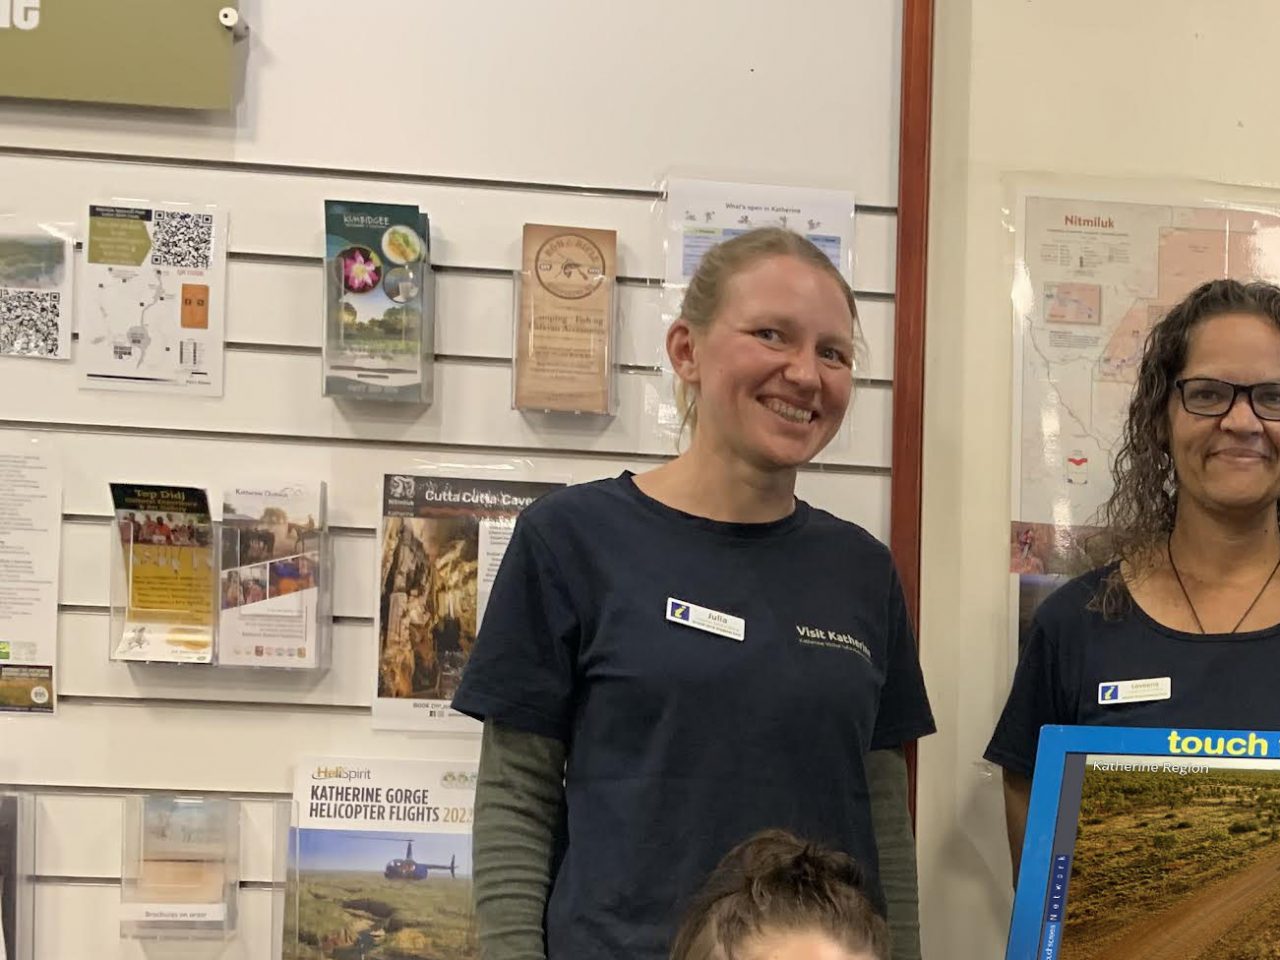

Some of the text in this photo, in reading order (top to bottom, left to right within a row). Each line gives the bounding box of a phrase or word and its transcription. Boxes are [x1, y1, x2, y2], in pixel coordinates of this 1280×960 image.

[1064, 215, 1114, 228] Nitmiluk
[425, 490, 460, 502] Cutta
[463, 491, 498, 505] Cutta
[708, 613, 728, 624] Julia
[796, 625, 826, 640] Visit
[1168, 730, 1268, 756] touch
[312, 767, 371, 781] HeliSpirit
[1093, 760, 1209, 775] Katherine Region
[311, 786, 428, 805] KATHERINE GORGE
[309, 803, 473, 823] HELICOPTER FLIGHTS 202
